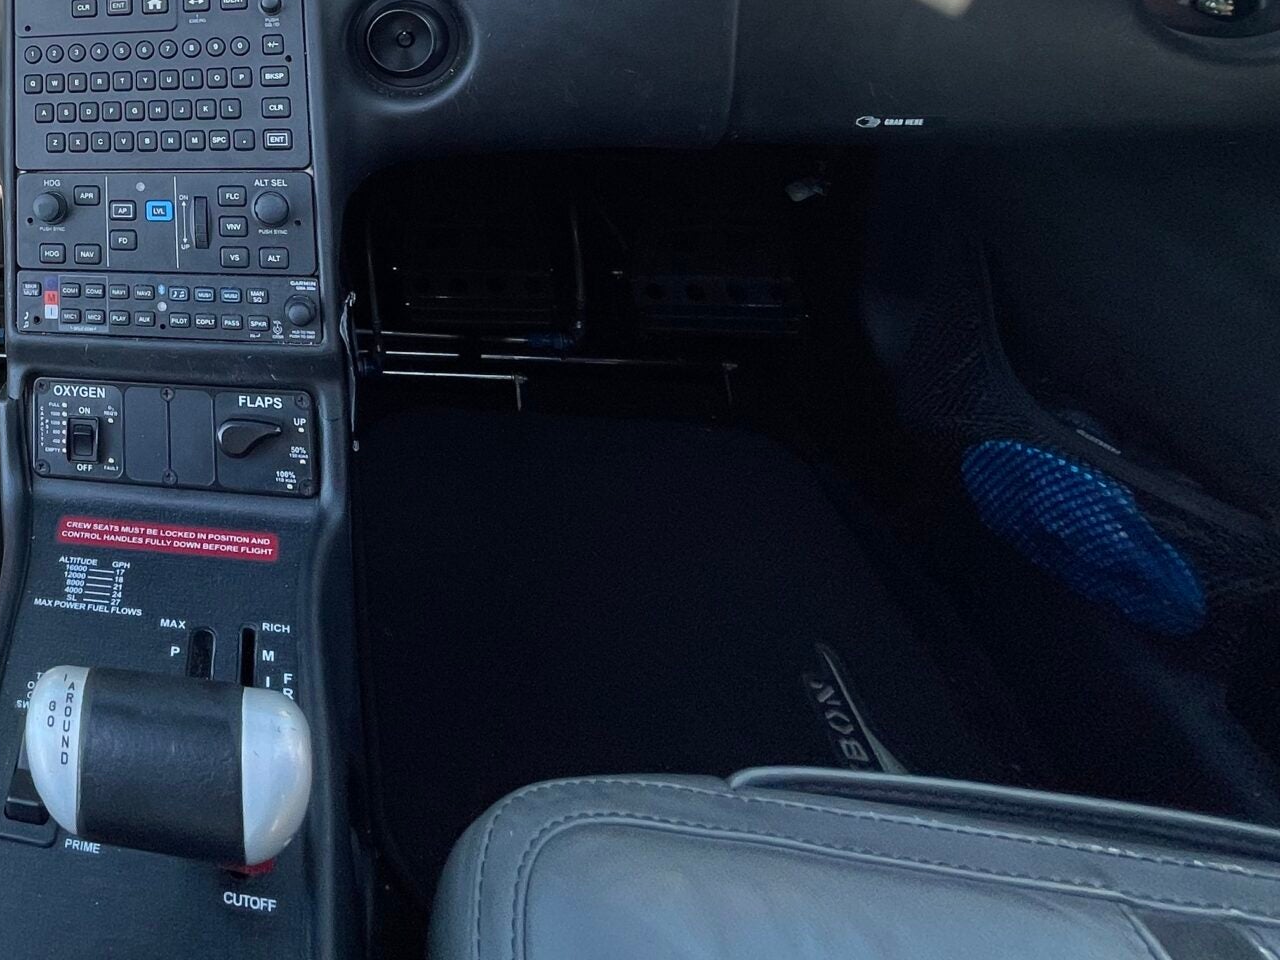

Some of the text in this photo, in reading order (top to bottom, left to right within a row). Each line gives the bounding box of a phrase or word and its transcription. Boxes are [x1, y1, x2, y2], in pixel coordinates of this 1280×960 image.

[48, 294, 55, 302] M
[54, 385, 106, 398] OXYGEN
[238, 395, 282, 409] FLAPS
[293, 418, 306, 426] UP
[291, 446, 306, 454] 50%
[66, 521, 91, 529] CREW
[93, 523, 120, 532] SEATS
[121, 526, 145, 534] MUST
[160, 530, 196, 539] LOCKED
[208, 534, 249, 544] POSITION
[251, 537, 270, 545] AND
[61, 530, 273, 555] CONTROL HANDLES FULLY DOWN BEFORE FLIGHT
[59, 556, 98, 566] ALTITUDE
[66, 564, 87, 572] 16000
[34, 598, 142, 616] MAX POWER FUEL FLOWS
[160, 618, 186, 630] MAX
[262, 622, 291, 634] RICH
[47, 700, 56, 727] GO
[61, 682, 75, 765] AROUND
[64, 839, 100, 854] PRIME
[223, 892, 277, 912] CUTOFF
